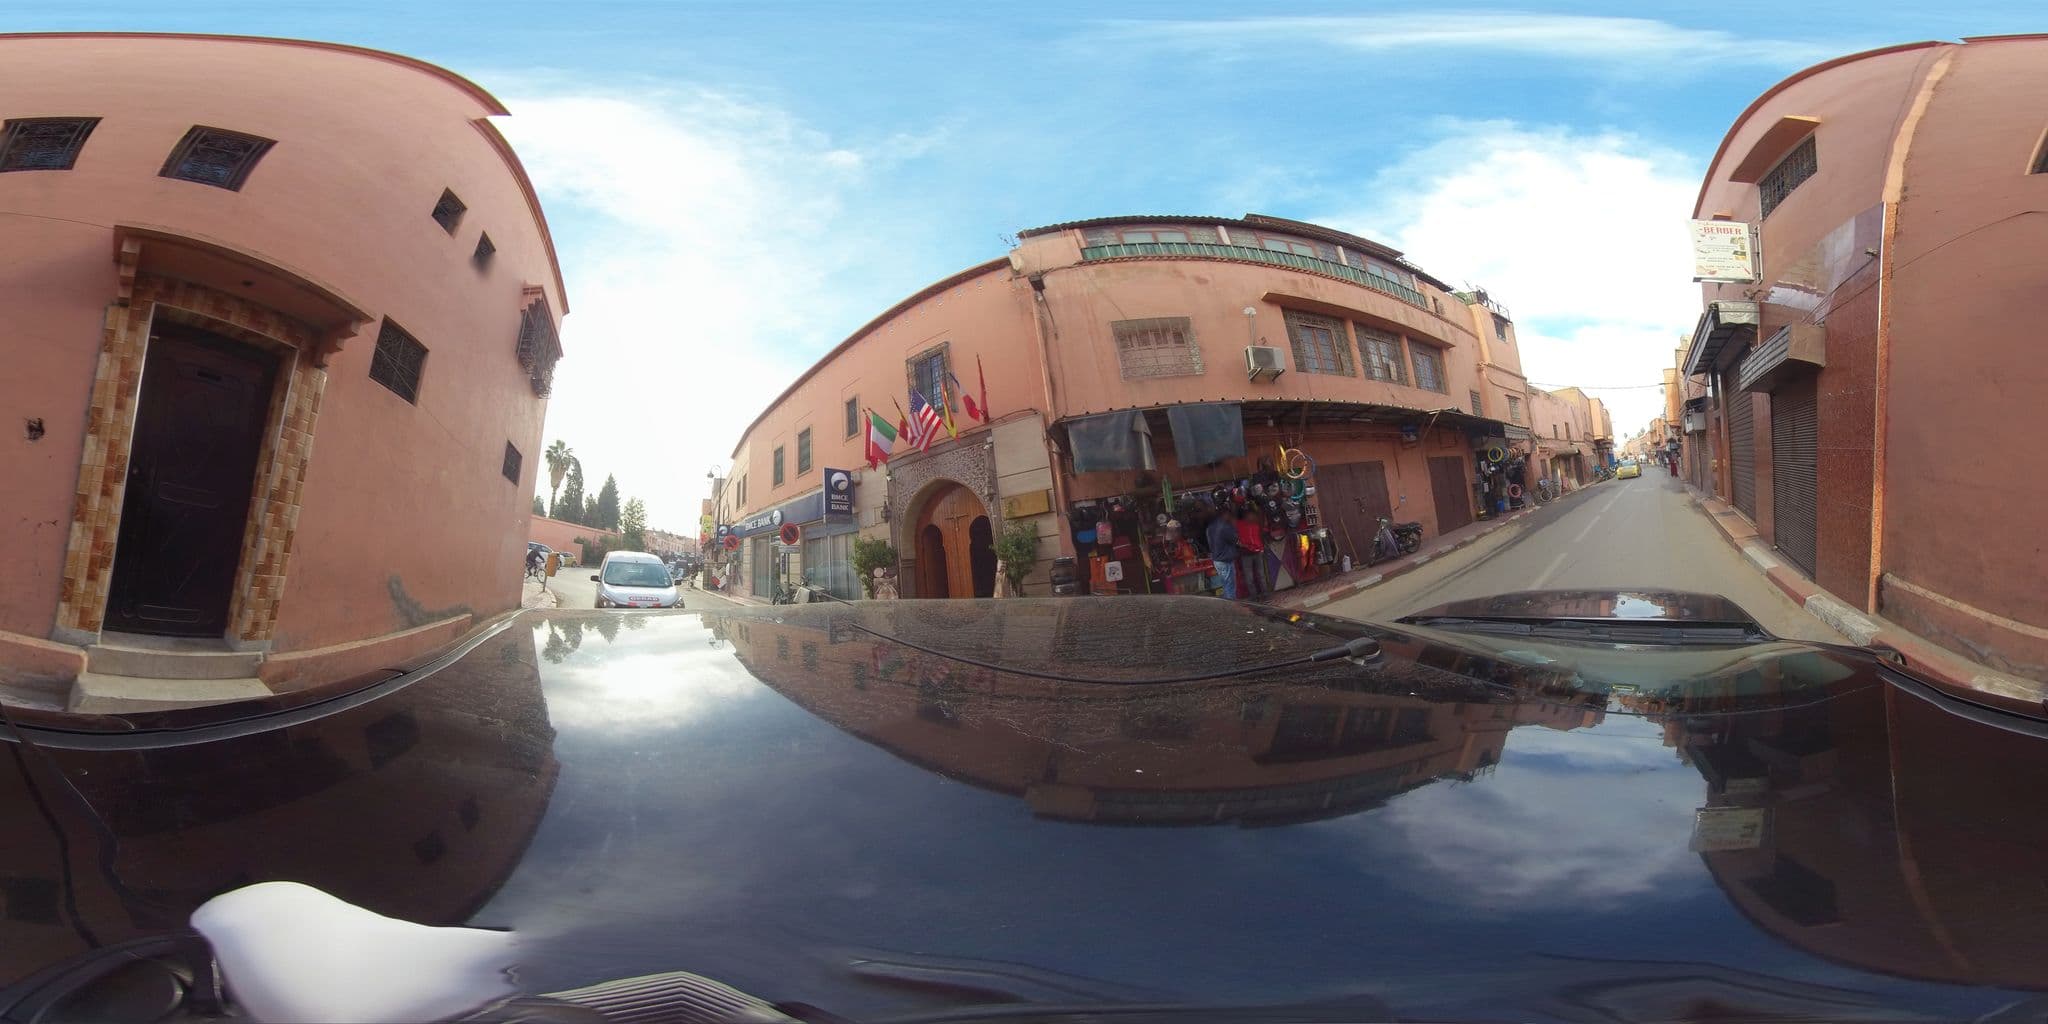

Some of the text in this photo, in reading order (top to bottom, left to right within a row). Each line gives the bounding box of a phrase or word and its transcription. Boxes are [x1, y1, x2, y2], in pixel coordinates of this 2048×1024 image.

[1703, 227, 1742, 235] BERBER
[832, 503, 848, 511] BANK
[745, 516, 772, 530] BMCE BANK
